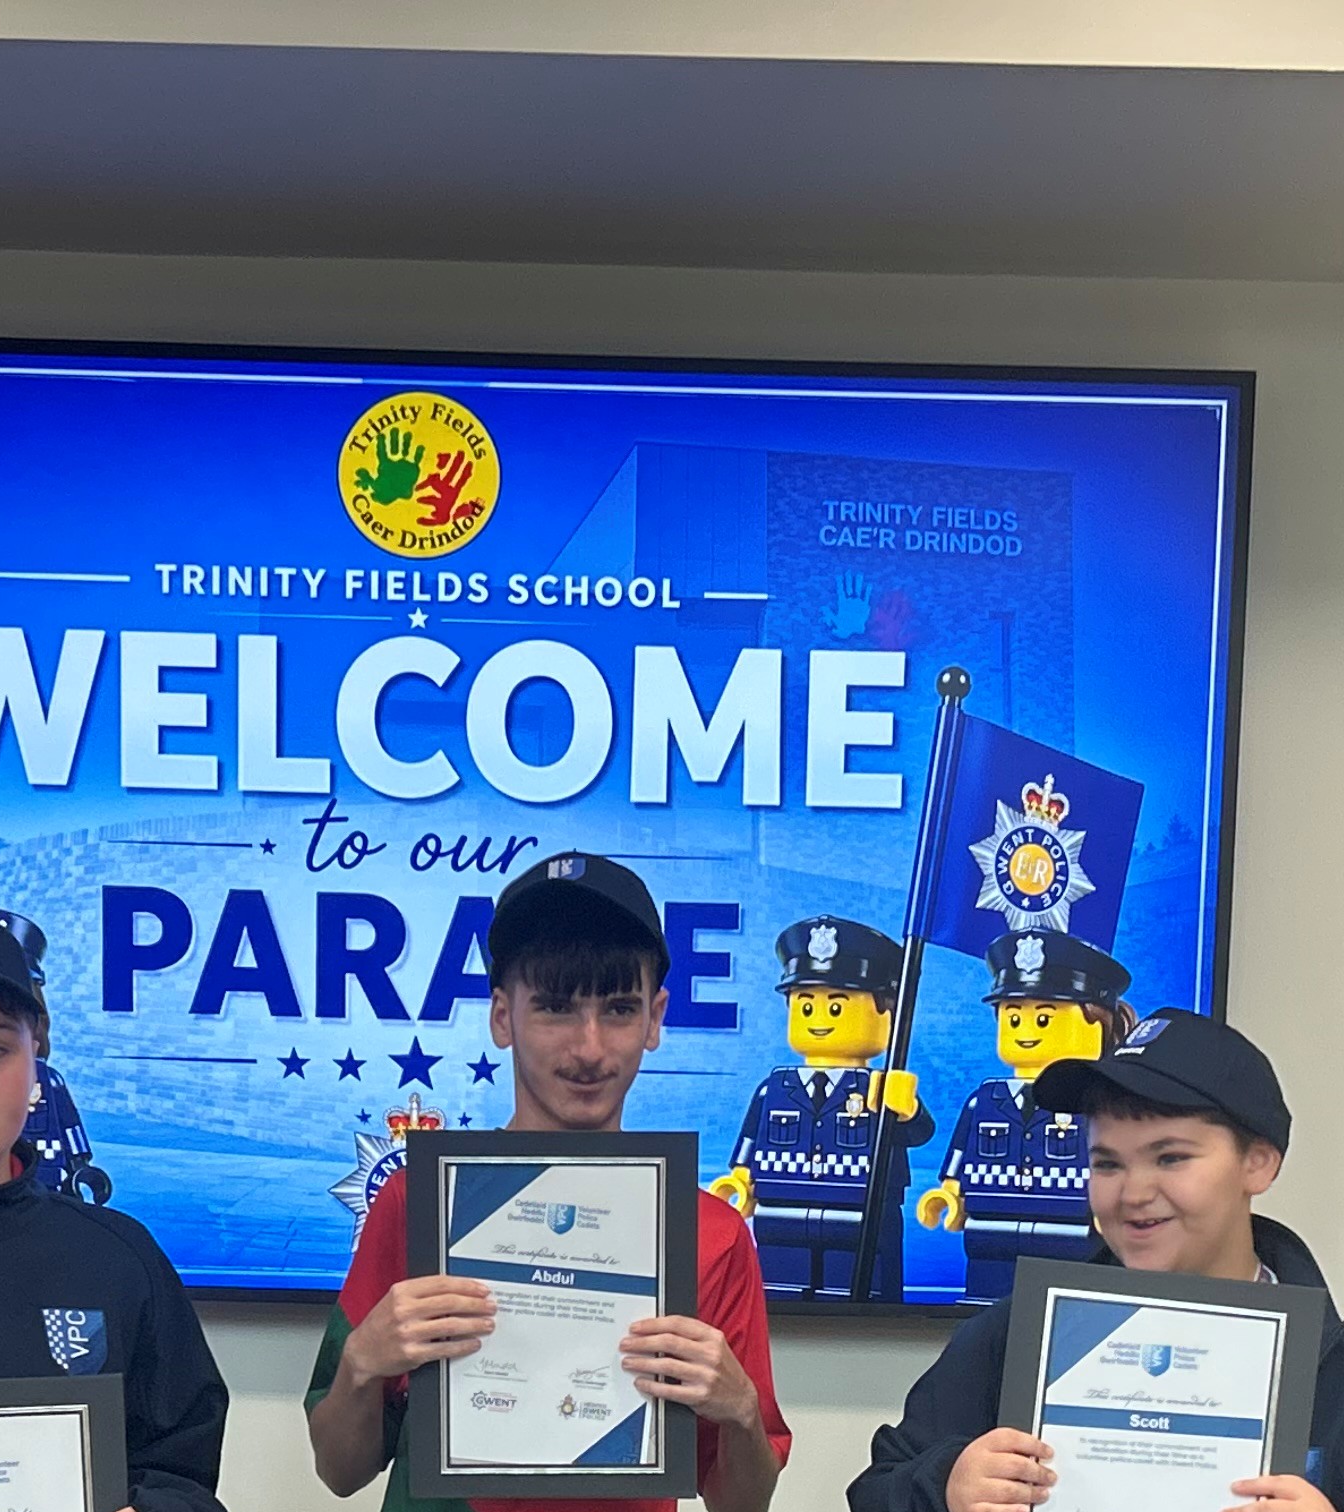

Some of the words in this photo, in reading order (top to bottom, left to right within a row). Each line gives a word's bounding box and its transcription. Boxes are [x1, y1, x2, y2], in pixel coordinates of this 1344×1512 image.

[349, 404, 421, 455] Trinity
[430, 403, 487, 460] Fields
[352, 493, 394, 542] Caer
[823, 500, 923, 526] TRINITY
[932, 506, 1018, 532] FIELDS
[819, 525, 896, 550] CAE'R
[905, 530, 1023, 557] DRINDOD
[155, 563, 326, 598] TRINITY
[344, 569, 491, 604] FIELDS
[506, 573, 682, 609] SCHOOL
[302, 798, 387, 873] to
[409, 834, 539, 874] our
[997, 829, 1034, 895] GWENT
[1041, 834, 1067, 908] POLICE
[102, 885, 741, 1029] PARAE
[531, 1269, 575, 1286] Abdul
[64, 1309, 90, 1359] VPC
[475, 1396, 518, 1408] GWENT
[1129, 1414, 1171, 1430] Scott
